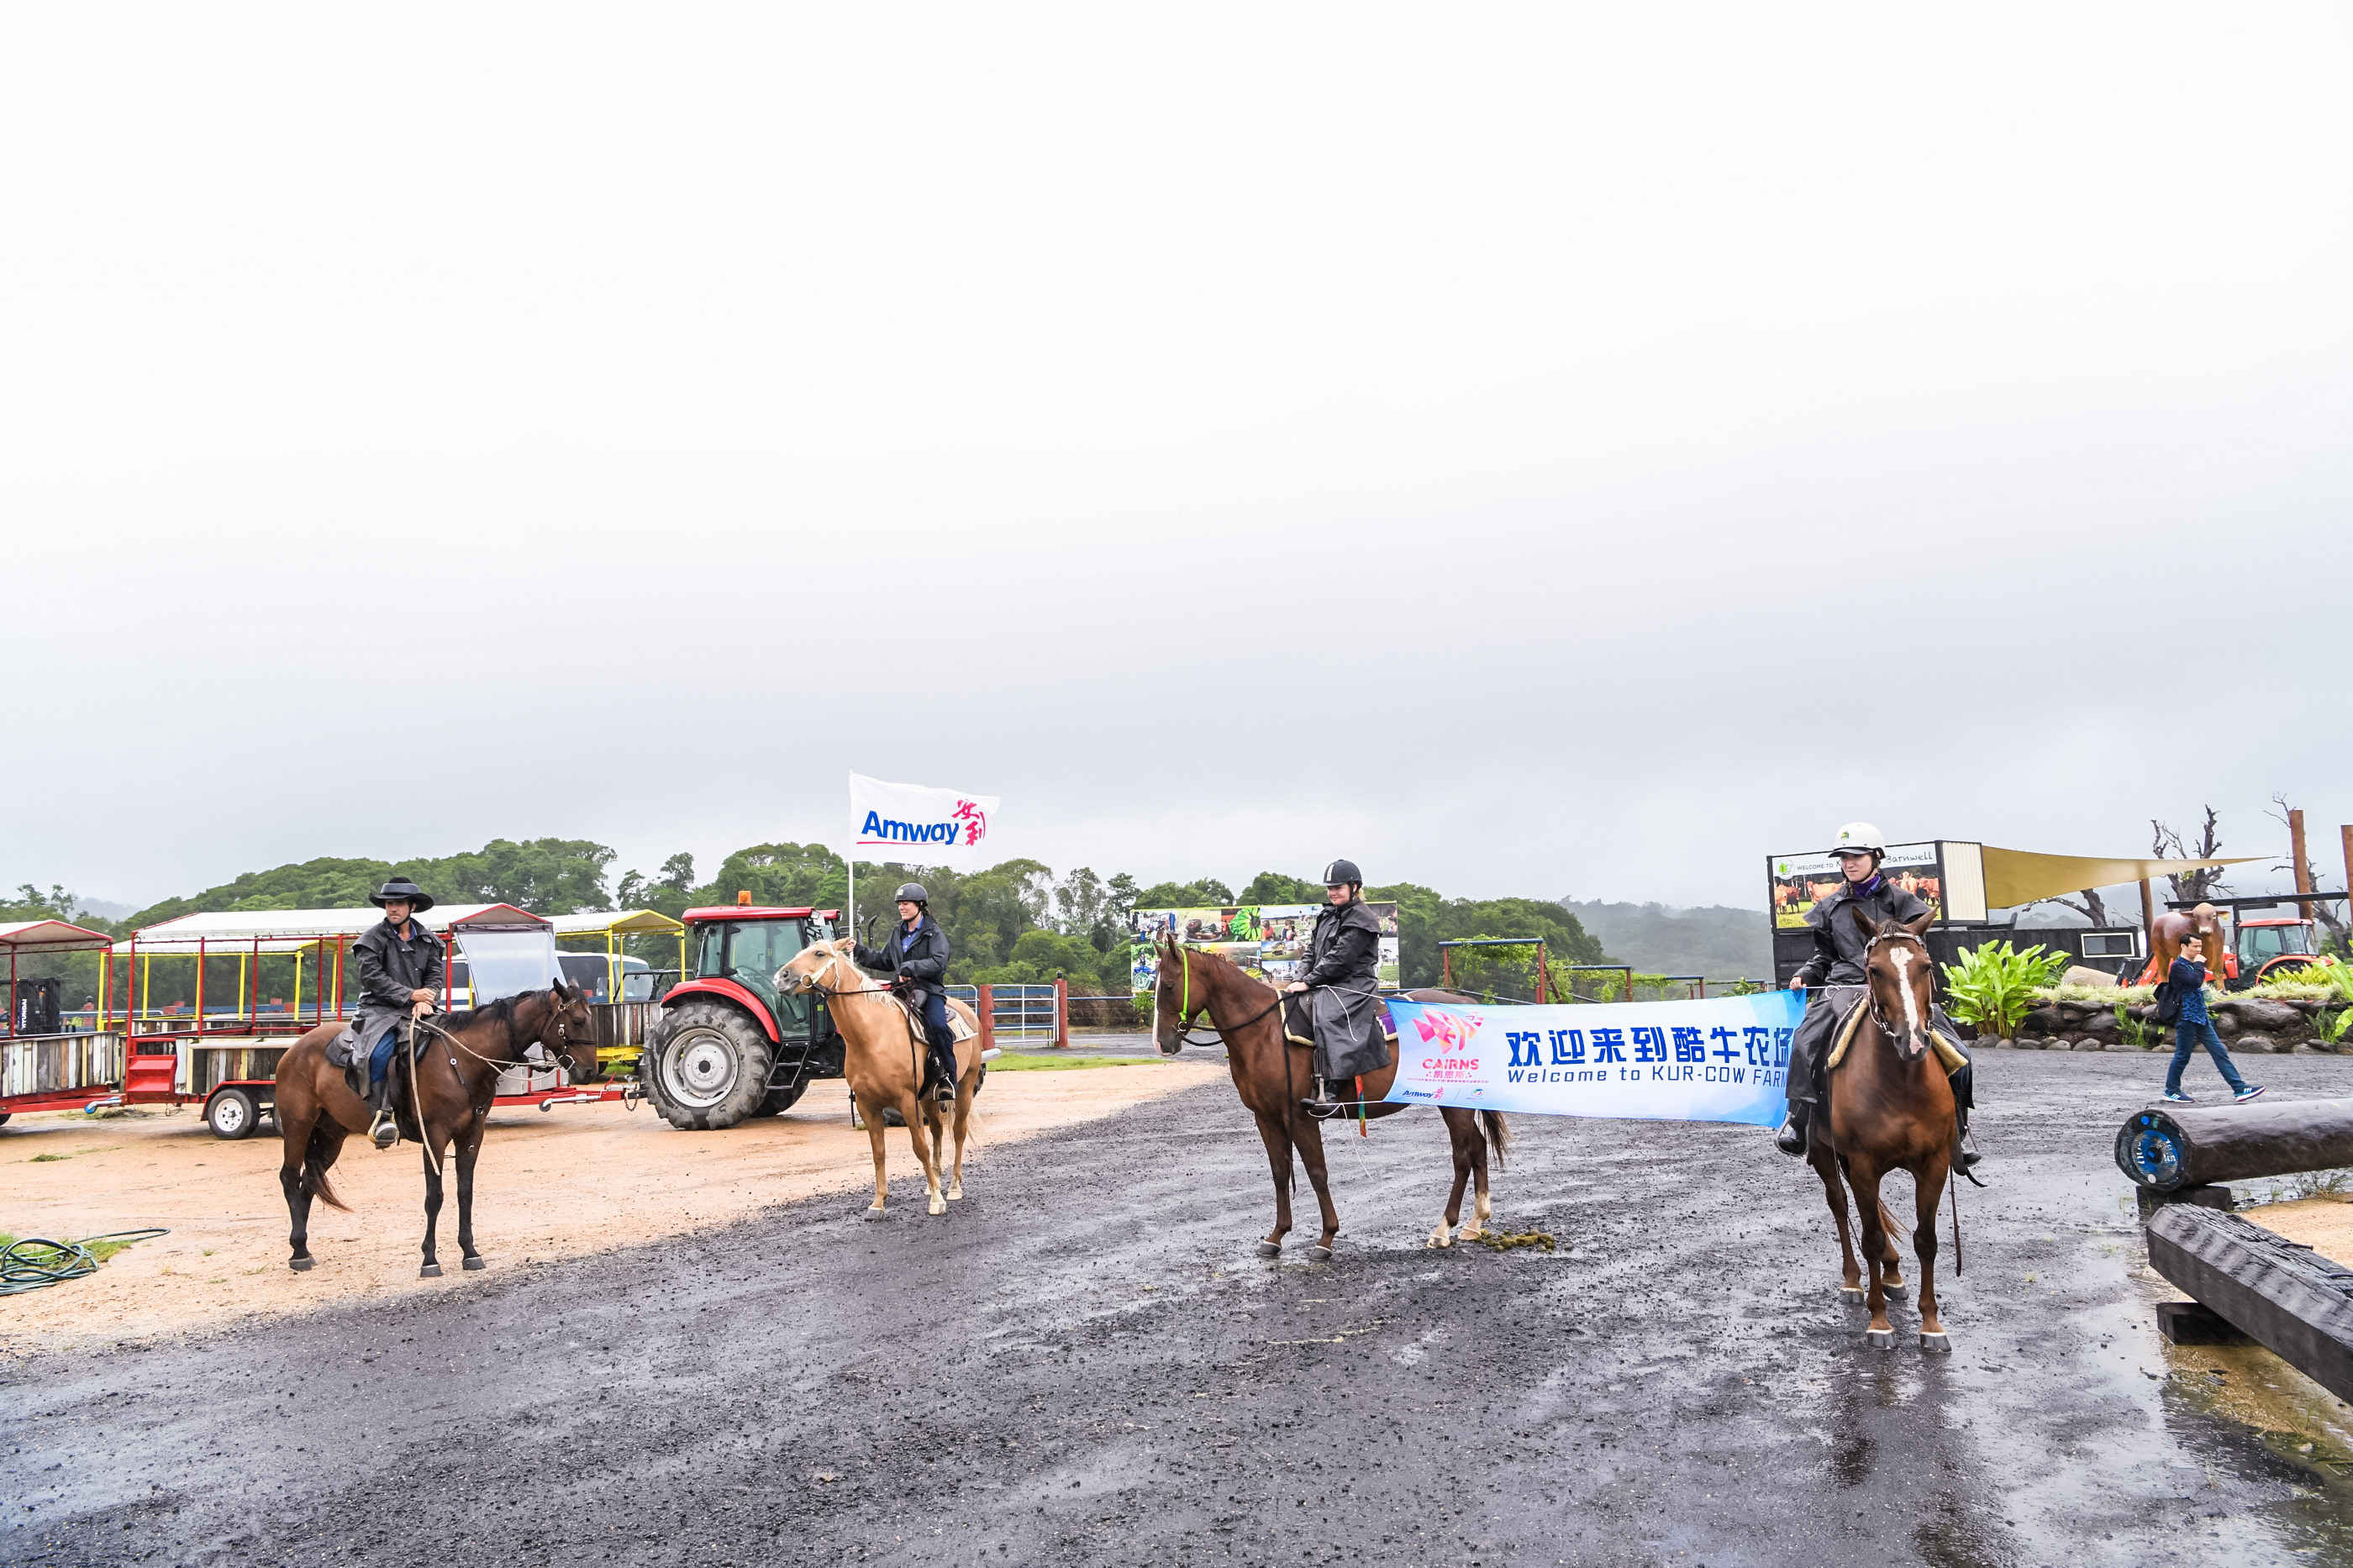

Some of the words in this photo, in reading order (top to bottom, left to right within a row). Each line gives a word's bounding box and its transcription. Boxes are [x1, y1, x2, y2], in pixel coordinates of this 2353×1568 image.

[861, 810, 960, 845] Amway
[1885, 851, 1933, 864] Barnwell
[1505, 1026, 1794, 1068] 欢迎来到酷牛农场
[1422, 1058, 1480, 1071] CAIRNS
[1433, 1070, 1466, 1079] 凯恩斯
[1508, 1068, 1607, 1083] Welcome
[1619, 1066, 1640, 1081] to
[1652, 1066, 1745, 1084] KUR-COW
[1402, 1089, 1434, 1098] Amway
